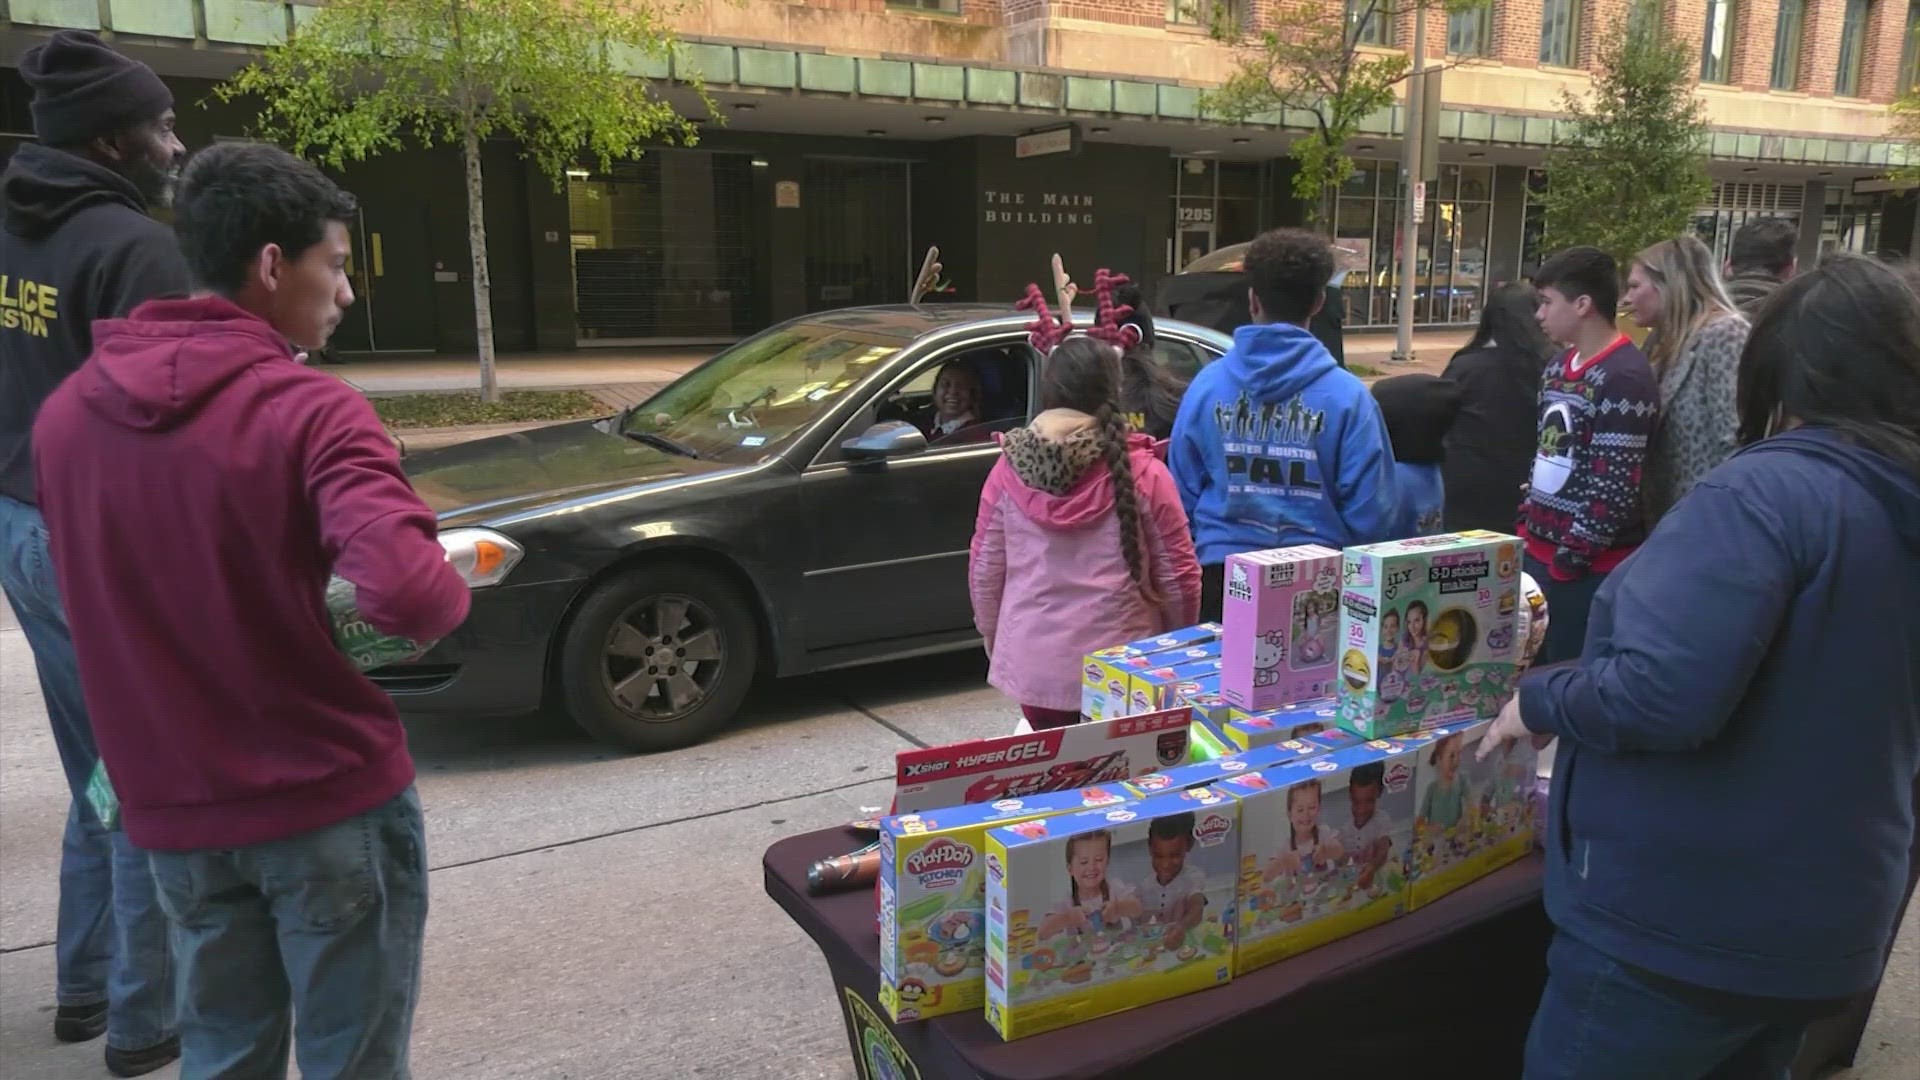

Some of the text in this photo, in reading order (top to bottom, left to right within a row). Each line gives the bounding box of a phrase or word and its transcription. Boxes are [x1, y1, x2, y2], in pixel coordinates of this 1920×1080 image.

[985, 191, 1093, 206] THE MAIN
[985, 210, 1093, 225] BUILDING
[1178, 207, 1212, 221] 1205
[0, 307, 48, 338] STON
[1225, 455, 1322, 490] PAL
[1271, 563, 1294, 572] HELLO
[1451, 563, 1487, 578] sticker
[1271, 571, 1294, 580] KITTY
[1229, 580, 1252, 594] HELLO
[1229, 589, 1252, 602] KITTY
[1350, 625, 1363, 638] 30
